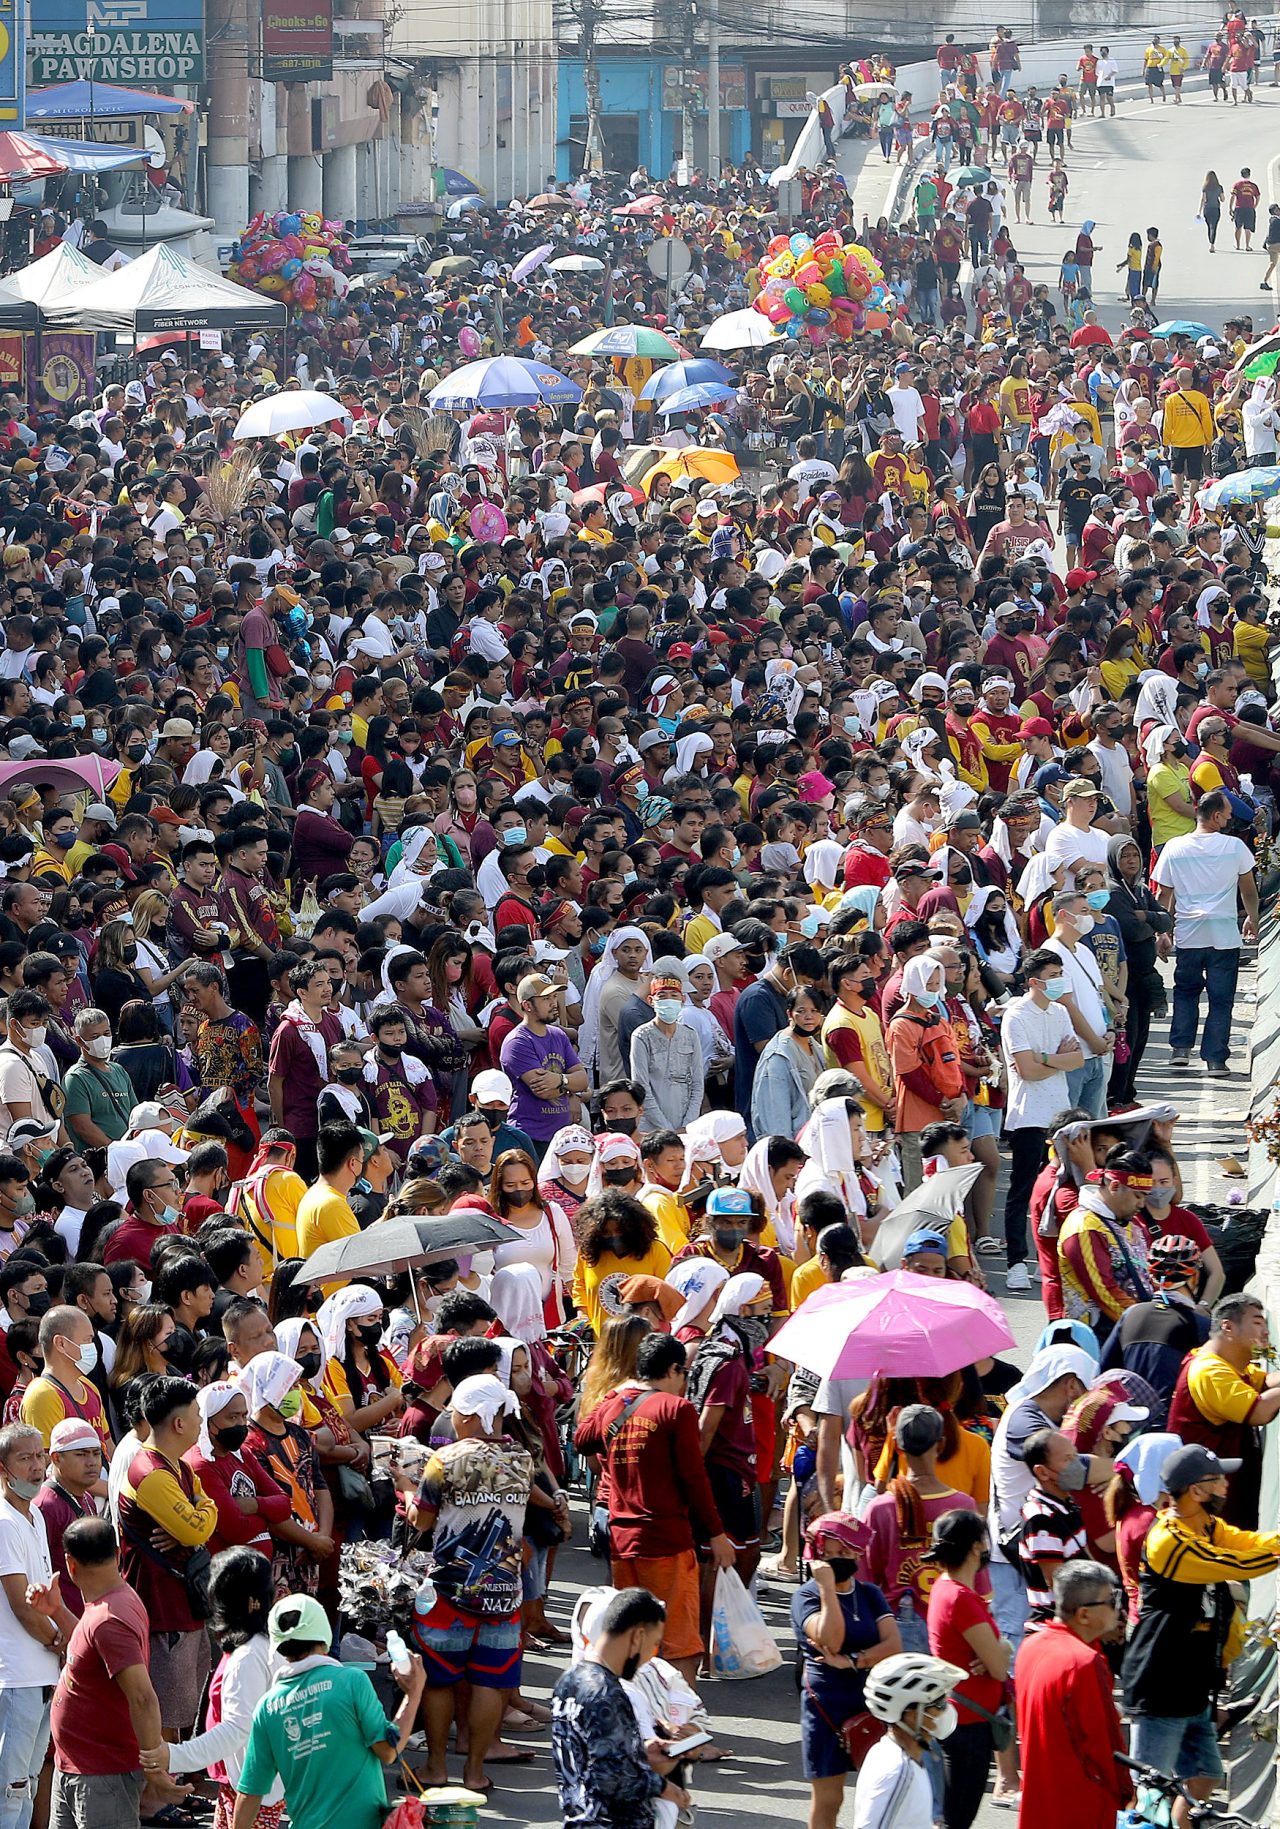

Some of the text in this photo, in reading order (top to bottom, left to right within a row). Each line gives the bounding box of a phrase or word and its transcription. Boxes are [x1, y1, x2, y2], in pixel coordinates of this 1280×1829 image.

[34, 33, 201, 55] MAGDALENA
[42, 56, 195, 79] PAWNSHOP
[94, 123, 130, 141] WU
[174, 319, 208, 327] NETWORK
[800, 471, 831, 482] Raiders
[1010, 535, 1030, 548] JESUS
[454, 1490, 501, 1507] BATANG
[483, 1583, 514, 1592] NUESTRO
[307, 1680, 333, 1696] UNITED
